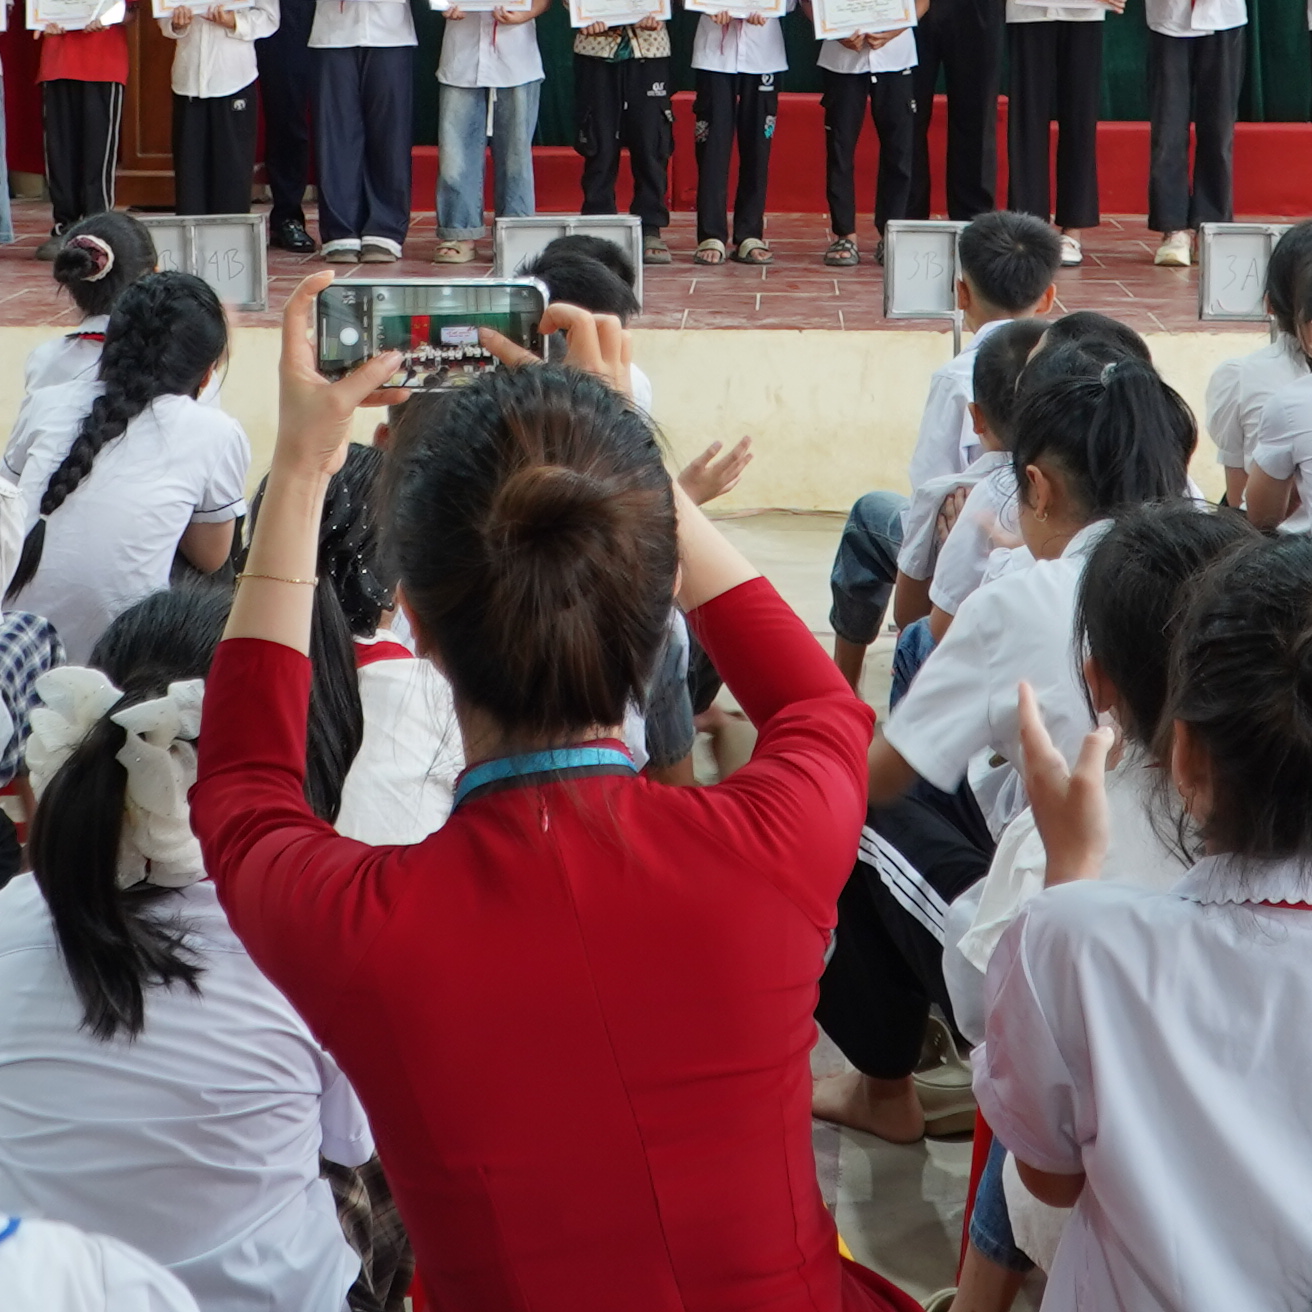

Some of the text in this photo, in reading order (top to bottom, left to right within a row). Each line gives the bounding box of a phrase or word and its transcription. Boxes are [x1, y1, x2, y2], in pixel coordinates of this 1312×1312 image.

[208, 248, 245, 282] 4B
[907, 250, 944, 281] 3B
[1221, 253, 1259, 292] 3A
